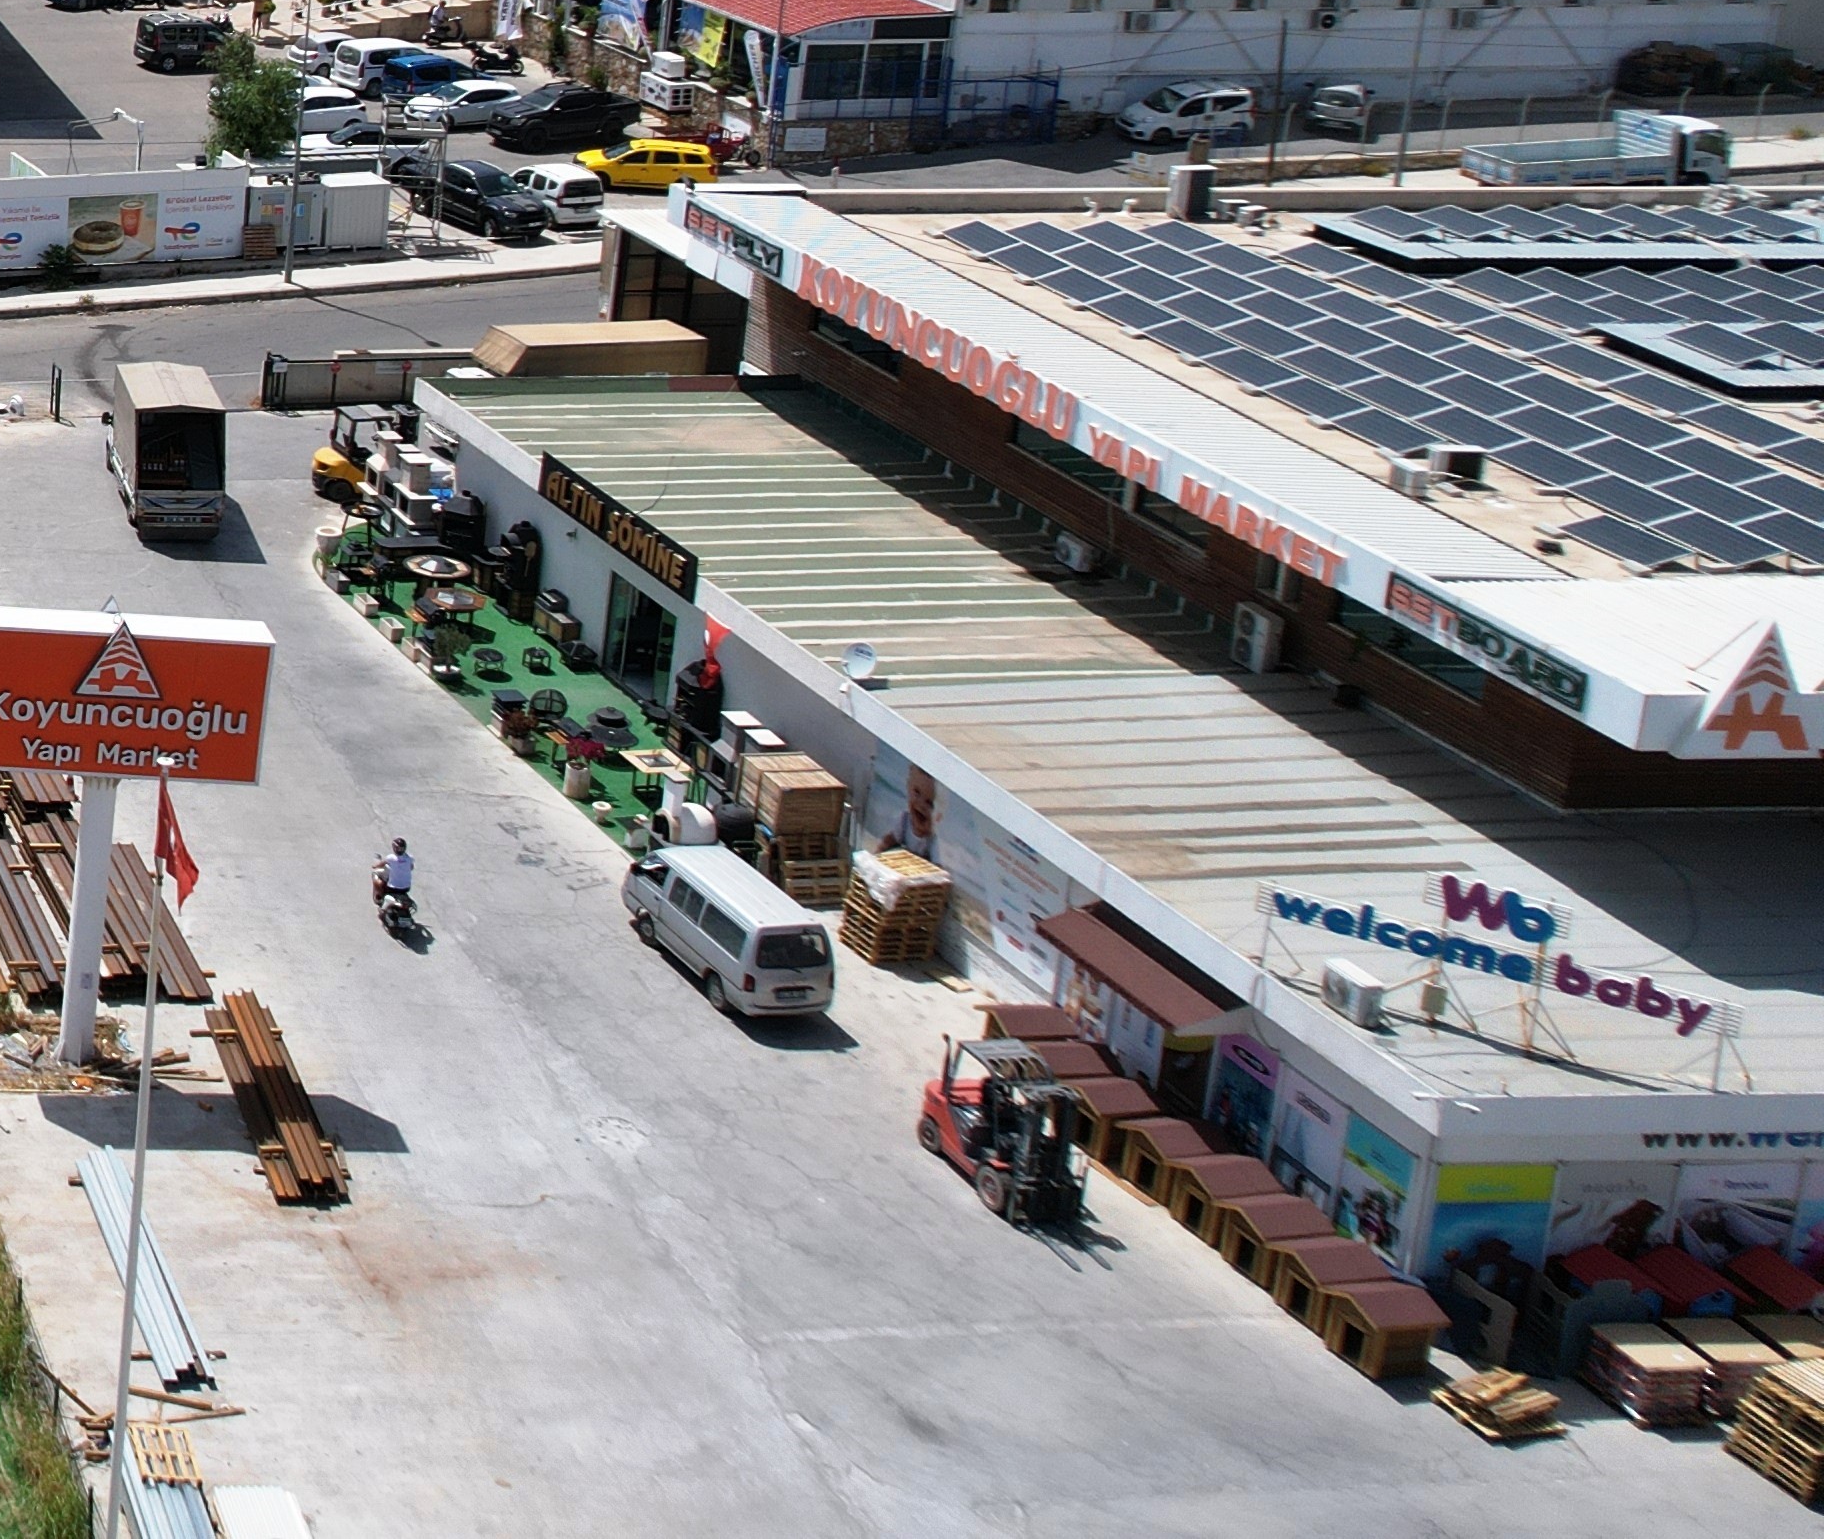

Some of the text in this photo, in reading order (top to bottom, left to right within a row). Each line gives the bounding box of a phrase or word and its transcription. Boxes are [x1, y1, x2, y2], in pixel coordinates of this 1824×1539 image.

[688, 208, 779, 269] SETPLY
[797, 251, 1078, 441] KOYUNCUOĞLU
[545, 470, 688, 590] ALTIN ŞÖMİNE
[1088, 422, 1350, 588] YAPI MARKET
[21, 737, 200, 770] Yapı Market
[1272, 890, 1713, 1037] welcome baby
